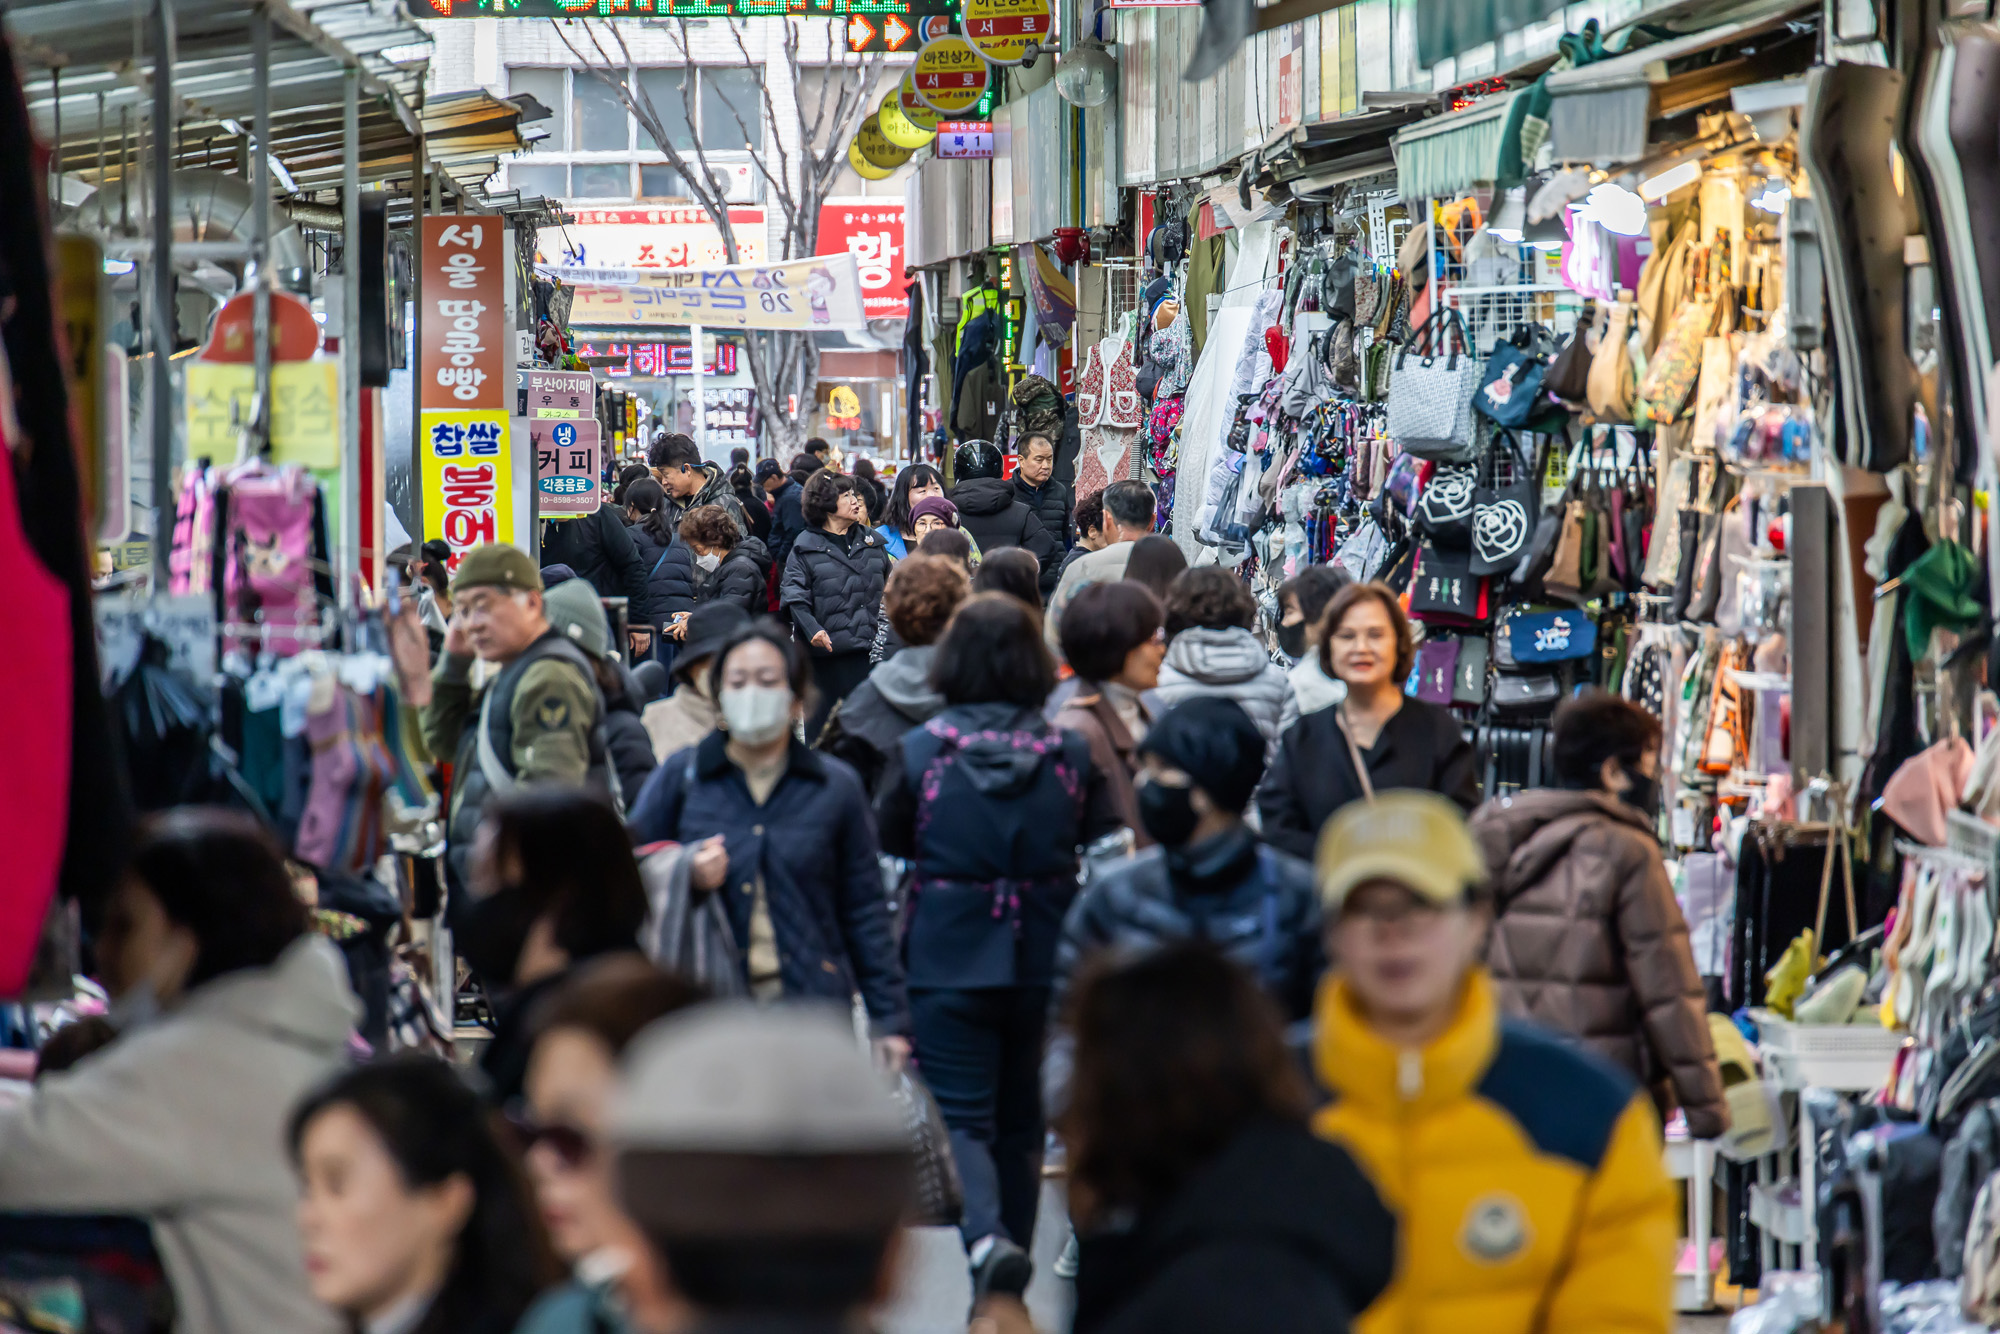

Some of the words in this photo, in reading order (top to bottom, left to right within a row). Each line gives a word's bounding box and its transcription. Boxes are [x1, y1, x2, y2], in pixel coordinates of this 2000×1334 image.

[924, 50, 976, 64] 아진상가
[949, 122, 986, 130] 아진상가
[974, 134, 980, 147] 1
[438, 223, 486, 289] 서울
[846, 230, 899, 289] 황
[436, 299, 487, 401] 땅콩빵
[531, 376, 591, 394] 부산아지매
[541, 395, 580, 407] 우동
[432, 422, 502, 457] 찹쌀
[557, 426, 572, 446] 냉
[539, 448, 592, 475] 커피
[543, 478, 587, 493] 각종음료
[443, 464, 495, 575] 붕어
